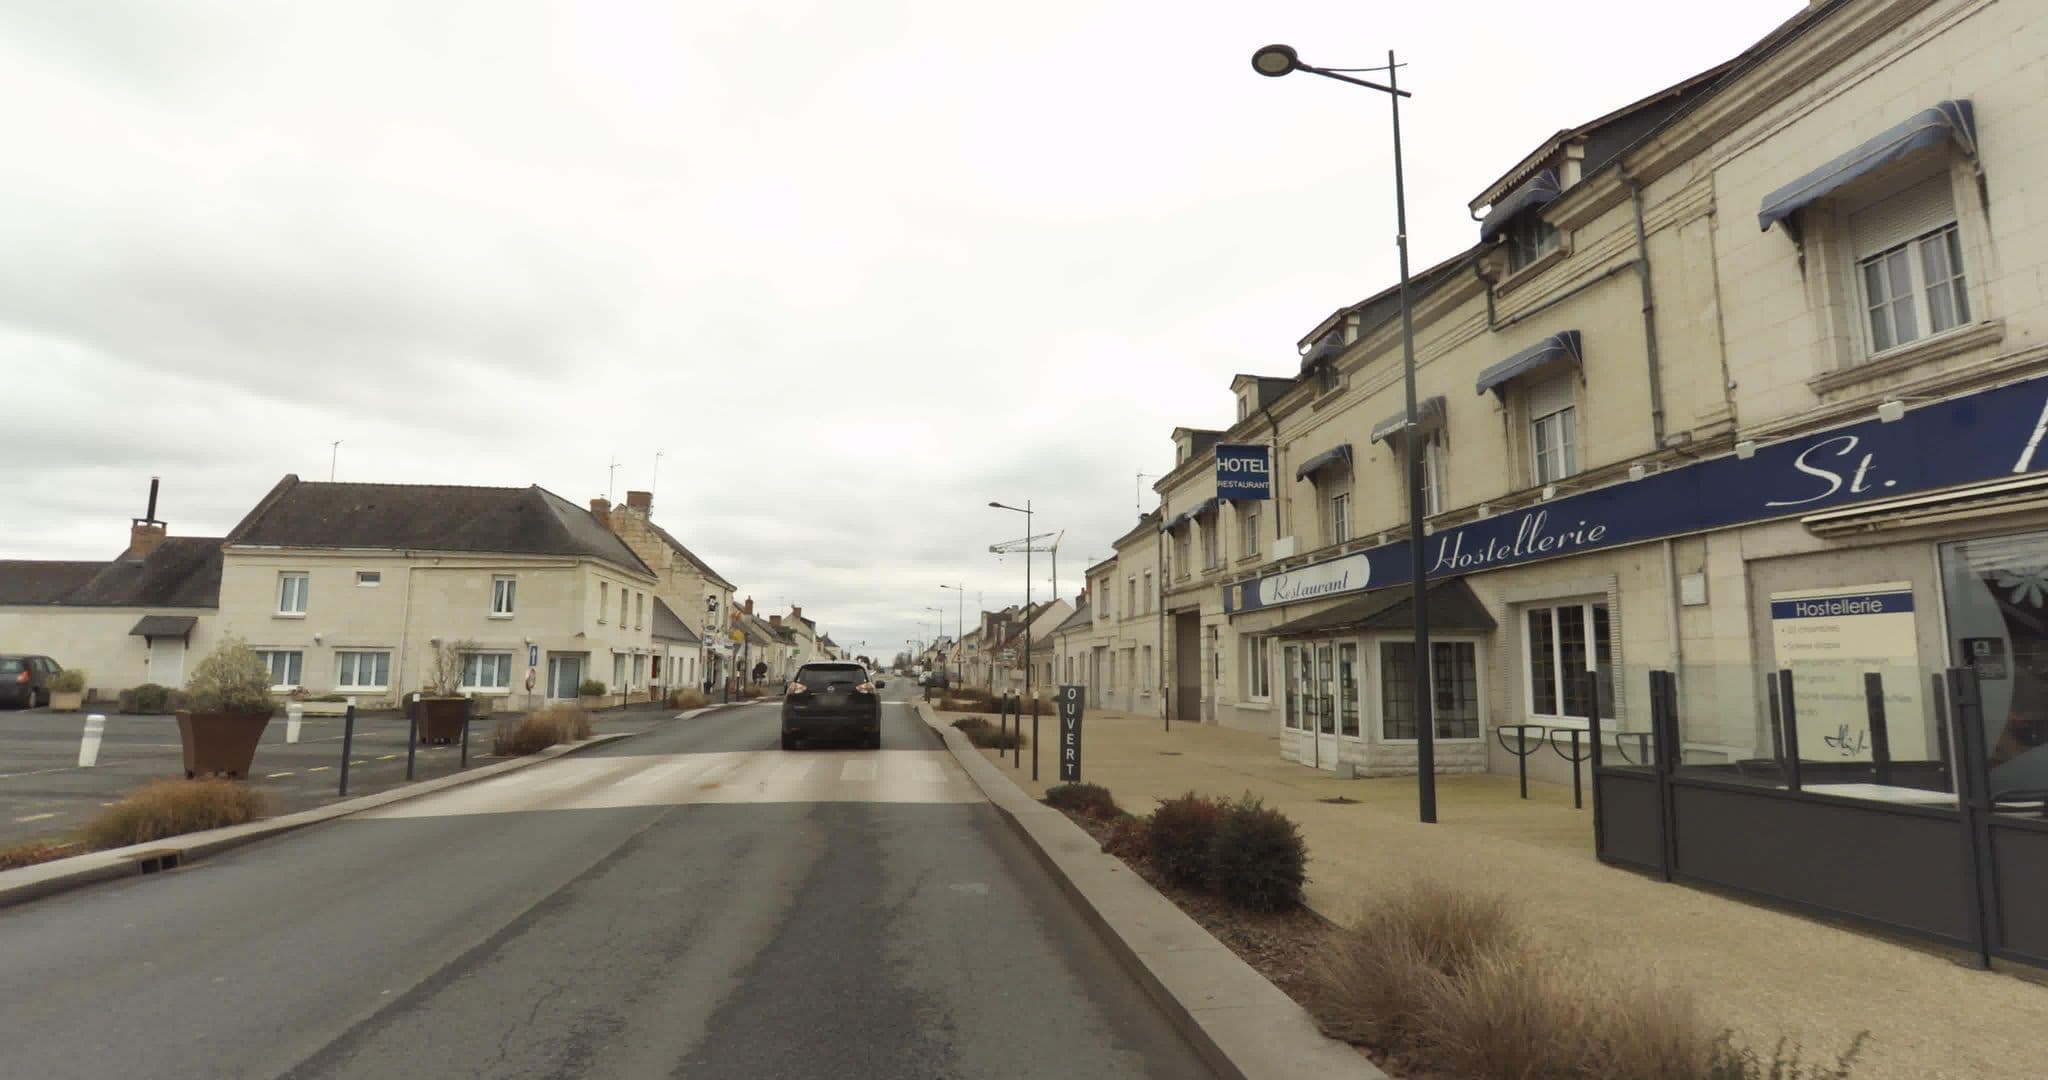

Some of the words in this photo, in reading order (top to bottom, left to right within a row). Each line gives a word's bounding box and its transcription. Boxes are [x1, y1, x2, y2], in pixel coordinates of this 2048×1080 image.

[1217, 458, 1269, 473] HOTEL
[1765, 435, 1897, 506] St.
[1217, 480, 1270, 489] RESTAURANT
[1426, 510, 1607, 575] Hostellerie
[1273, 569, 1349, 601] Restaurant
[1795, 597, 1883, 617] Hostellerie
[1065, 687, 1077, 775] OUVERT
